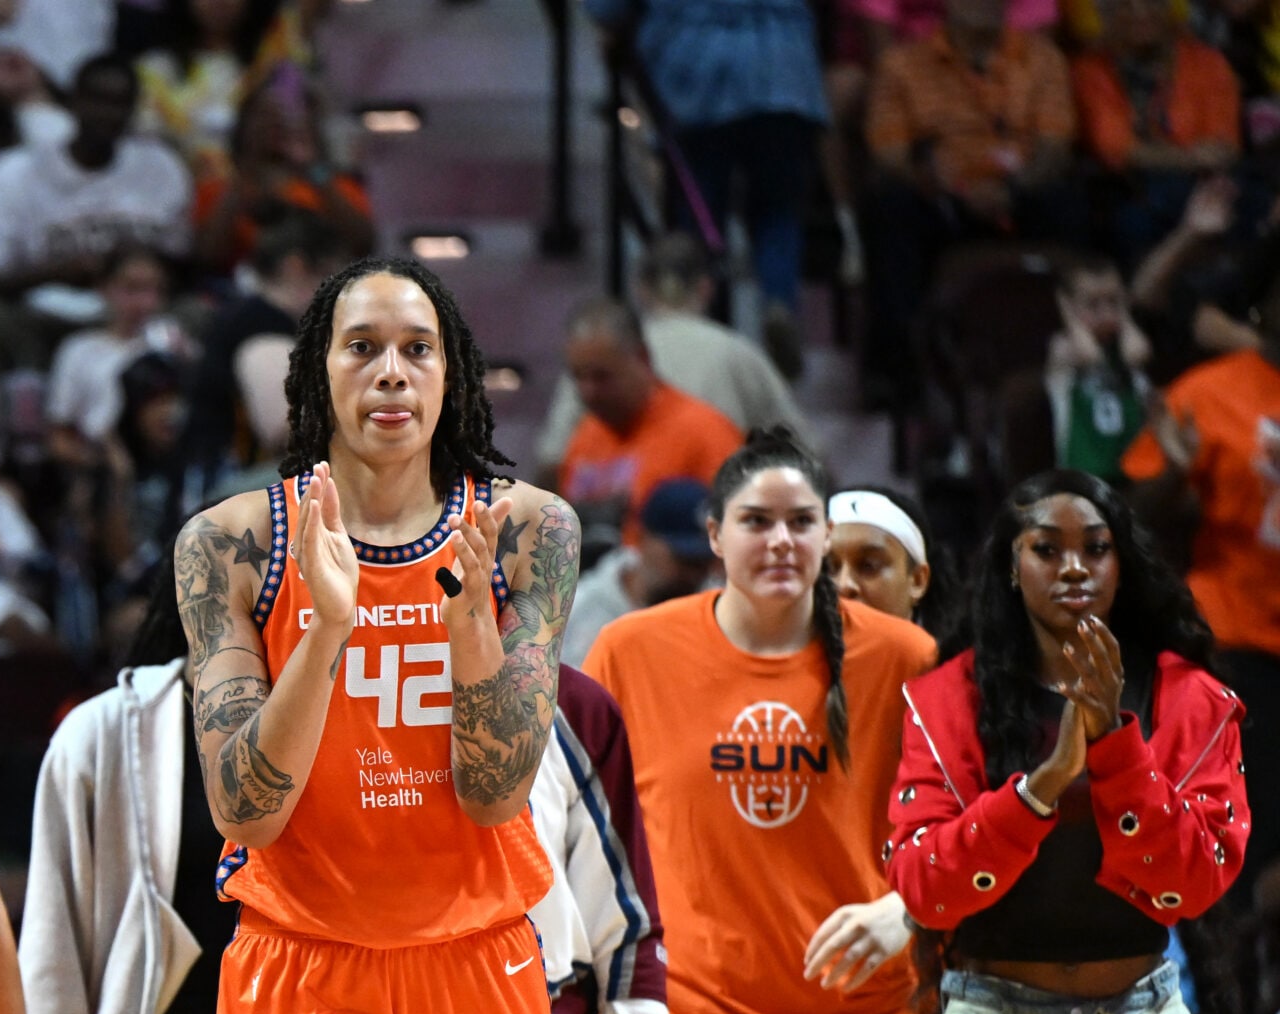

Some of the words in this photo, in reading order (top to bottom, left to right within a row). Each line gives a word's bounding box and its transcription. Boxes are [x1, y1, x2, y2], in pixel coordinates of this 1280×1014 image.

[298, 603, 446, 630] CNECTI
[345, 642, 453, 728] 42
[356, 747, 393, 766] Yale
[710, 744, 828, 773] SUN
[361, 788, 423, 808] Health
